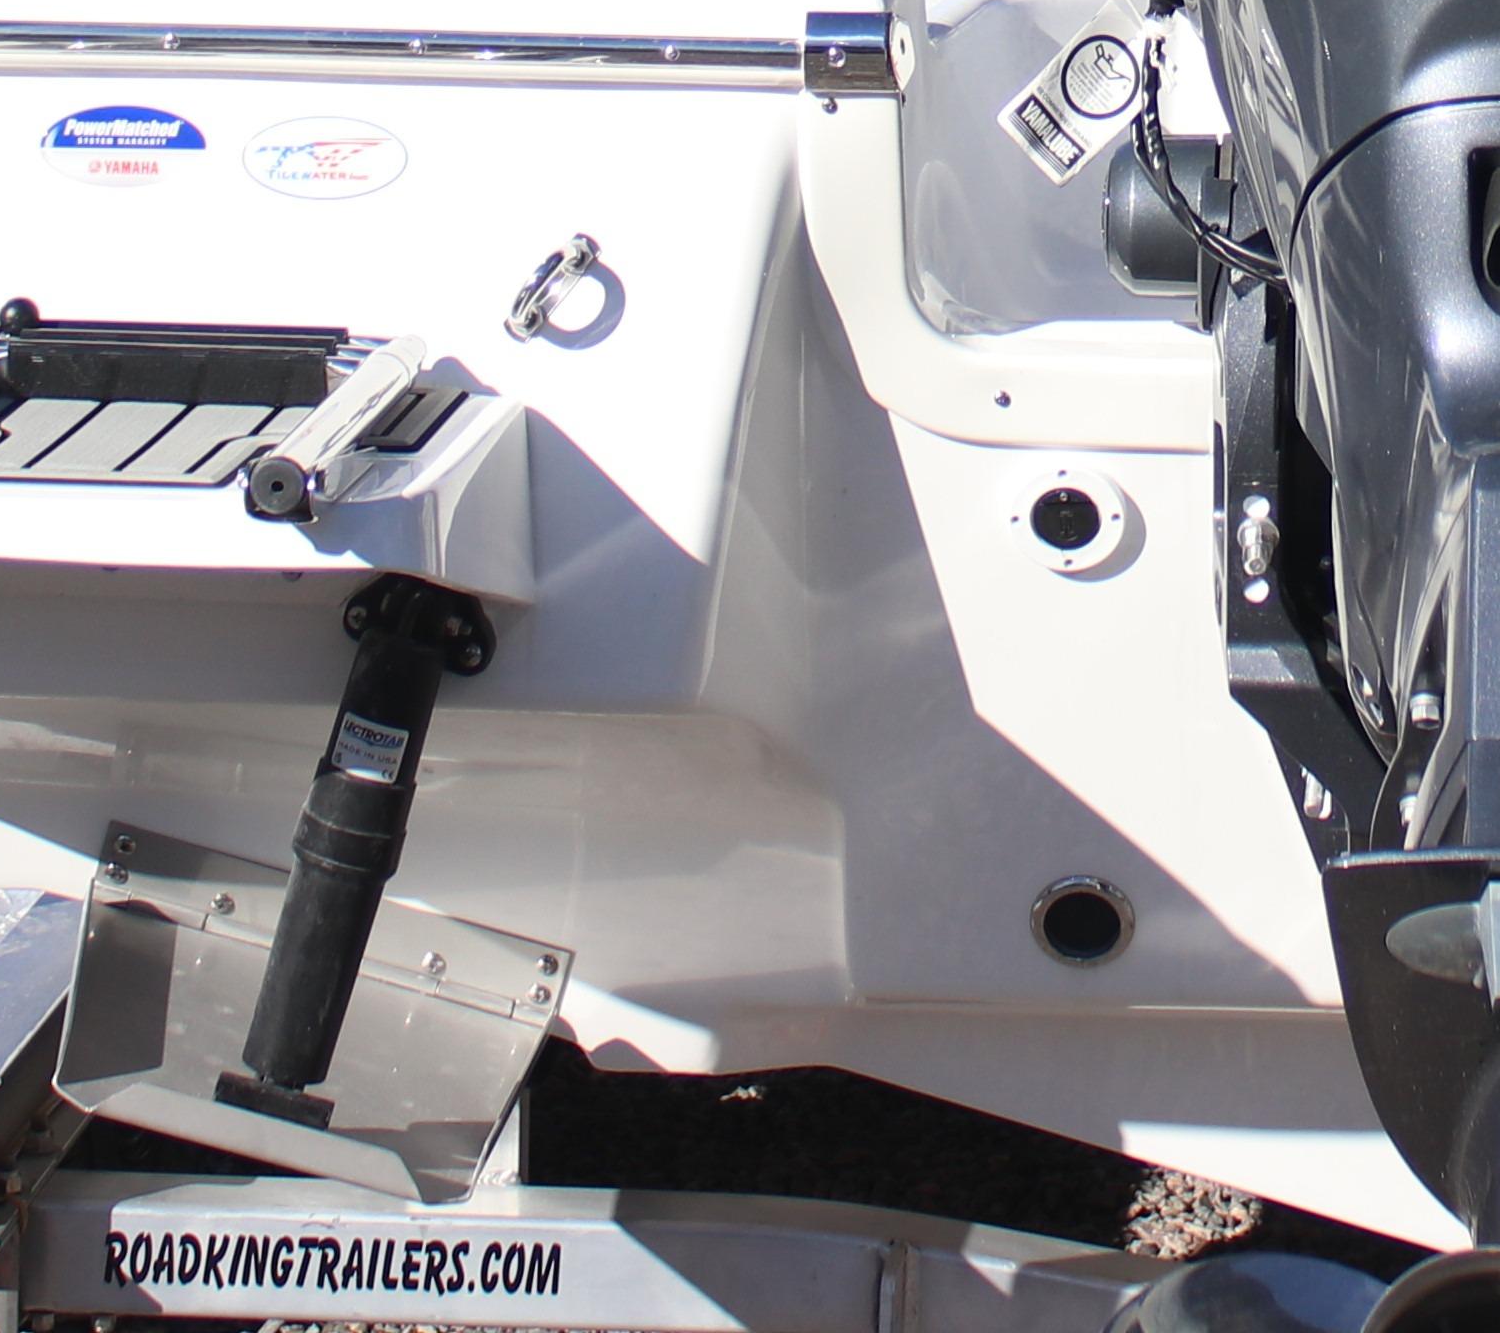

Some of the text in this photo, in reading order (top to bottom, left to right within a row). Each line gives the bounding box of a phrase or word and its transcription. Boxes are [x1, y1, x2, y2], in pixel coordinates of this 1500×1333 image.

[63, 118, 183, 137] PowerMatched
[1020, 99, 1080, 166] YAMALUBE
[104, 161, 159, 174] YAMAHA
[103, 1230, 561, 1296] ROADKINGTRAILERS.COM
